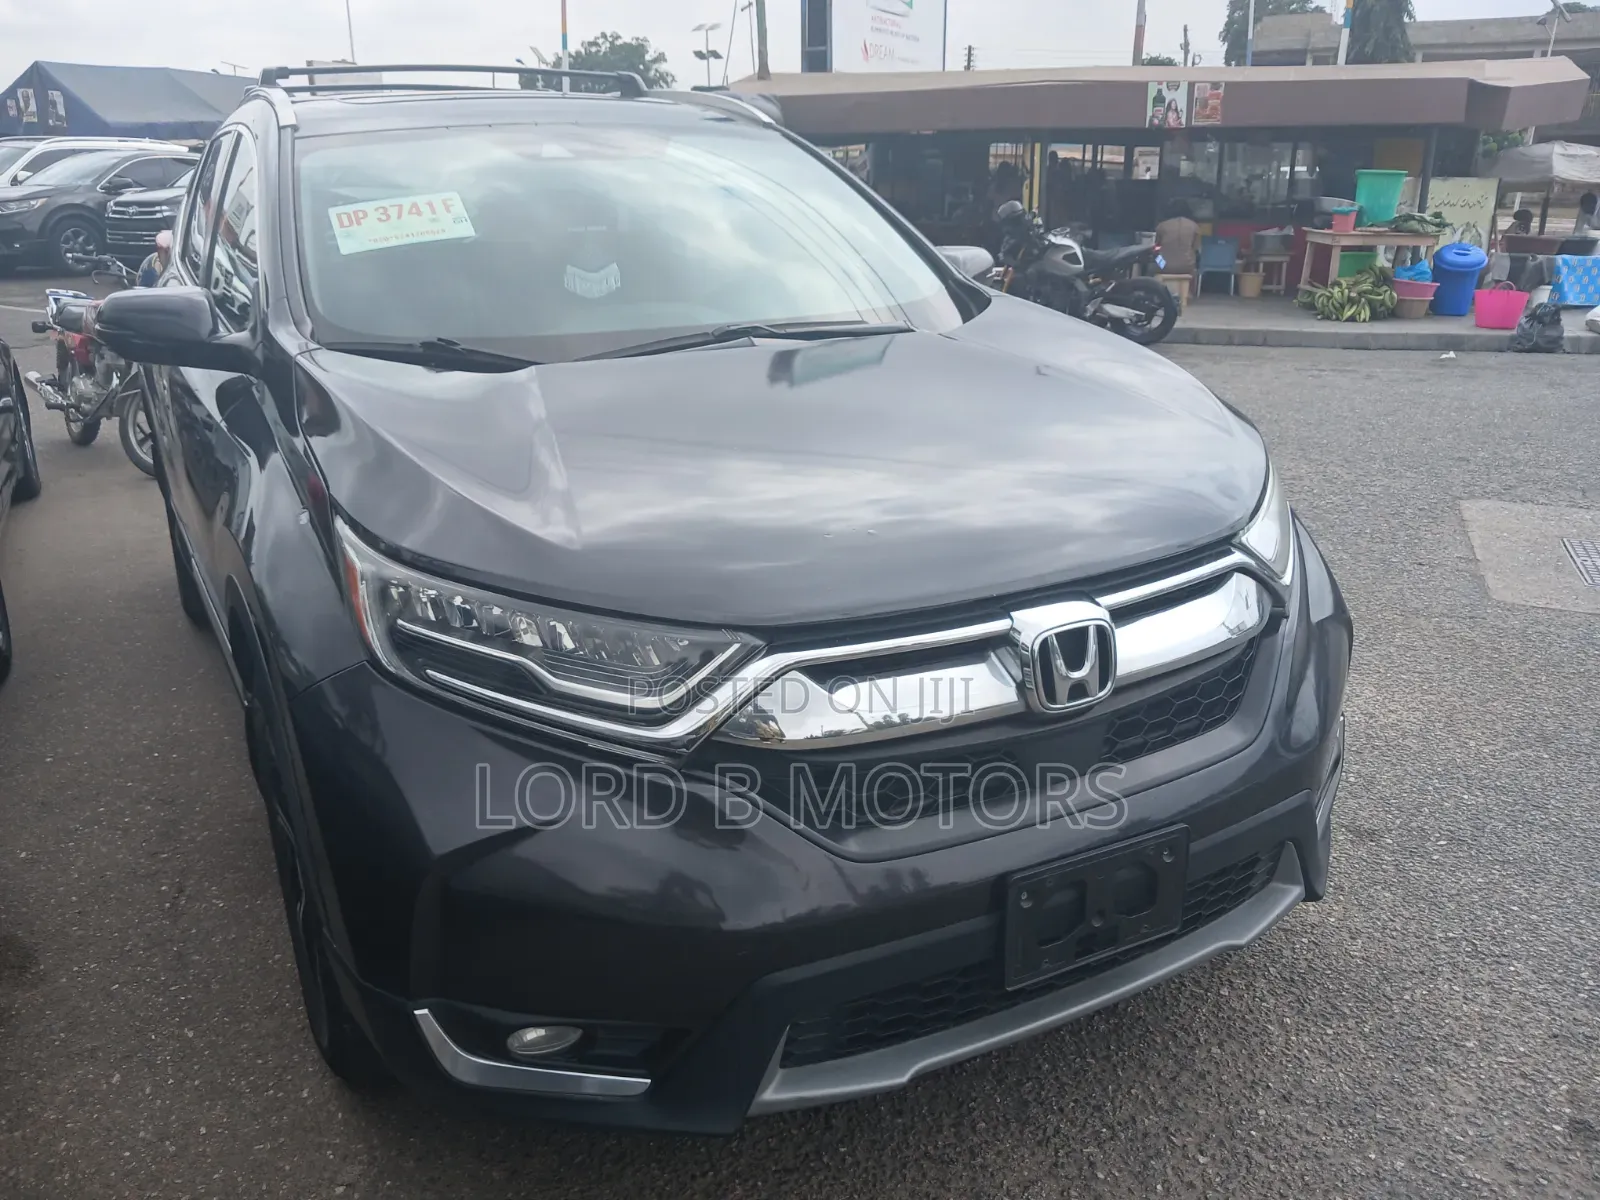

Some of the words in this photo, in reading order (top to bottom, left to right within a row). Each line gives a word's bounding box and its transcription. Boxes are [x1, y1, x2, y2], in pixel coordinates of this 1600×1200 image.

[335, 209, 369, 229] DP
[374, 200, 437, 223] 3741
[441, 198, 456, 214] F
